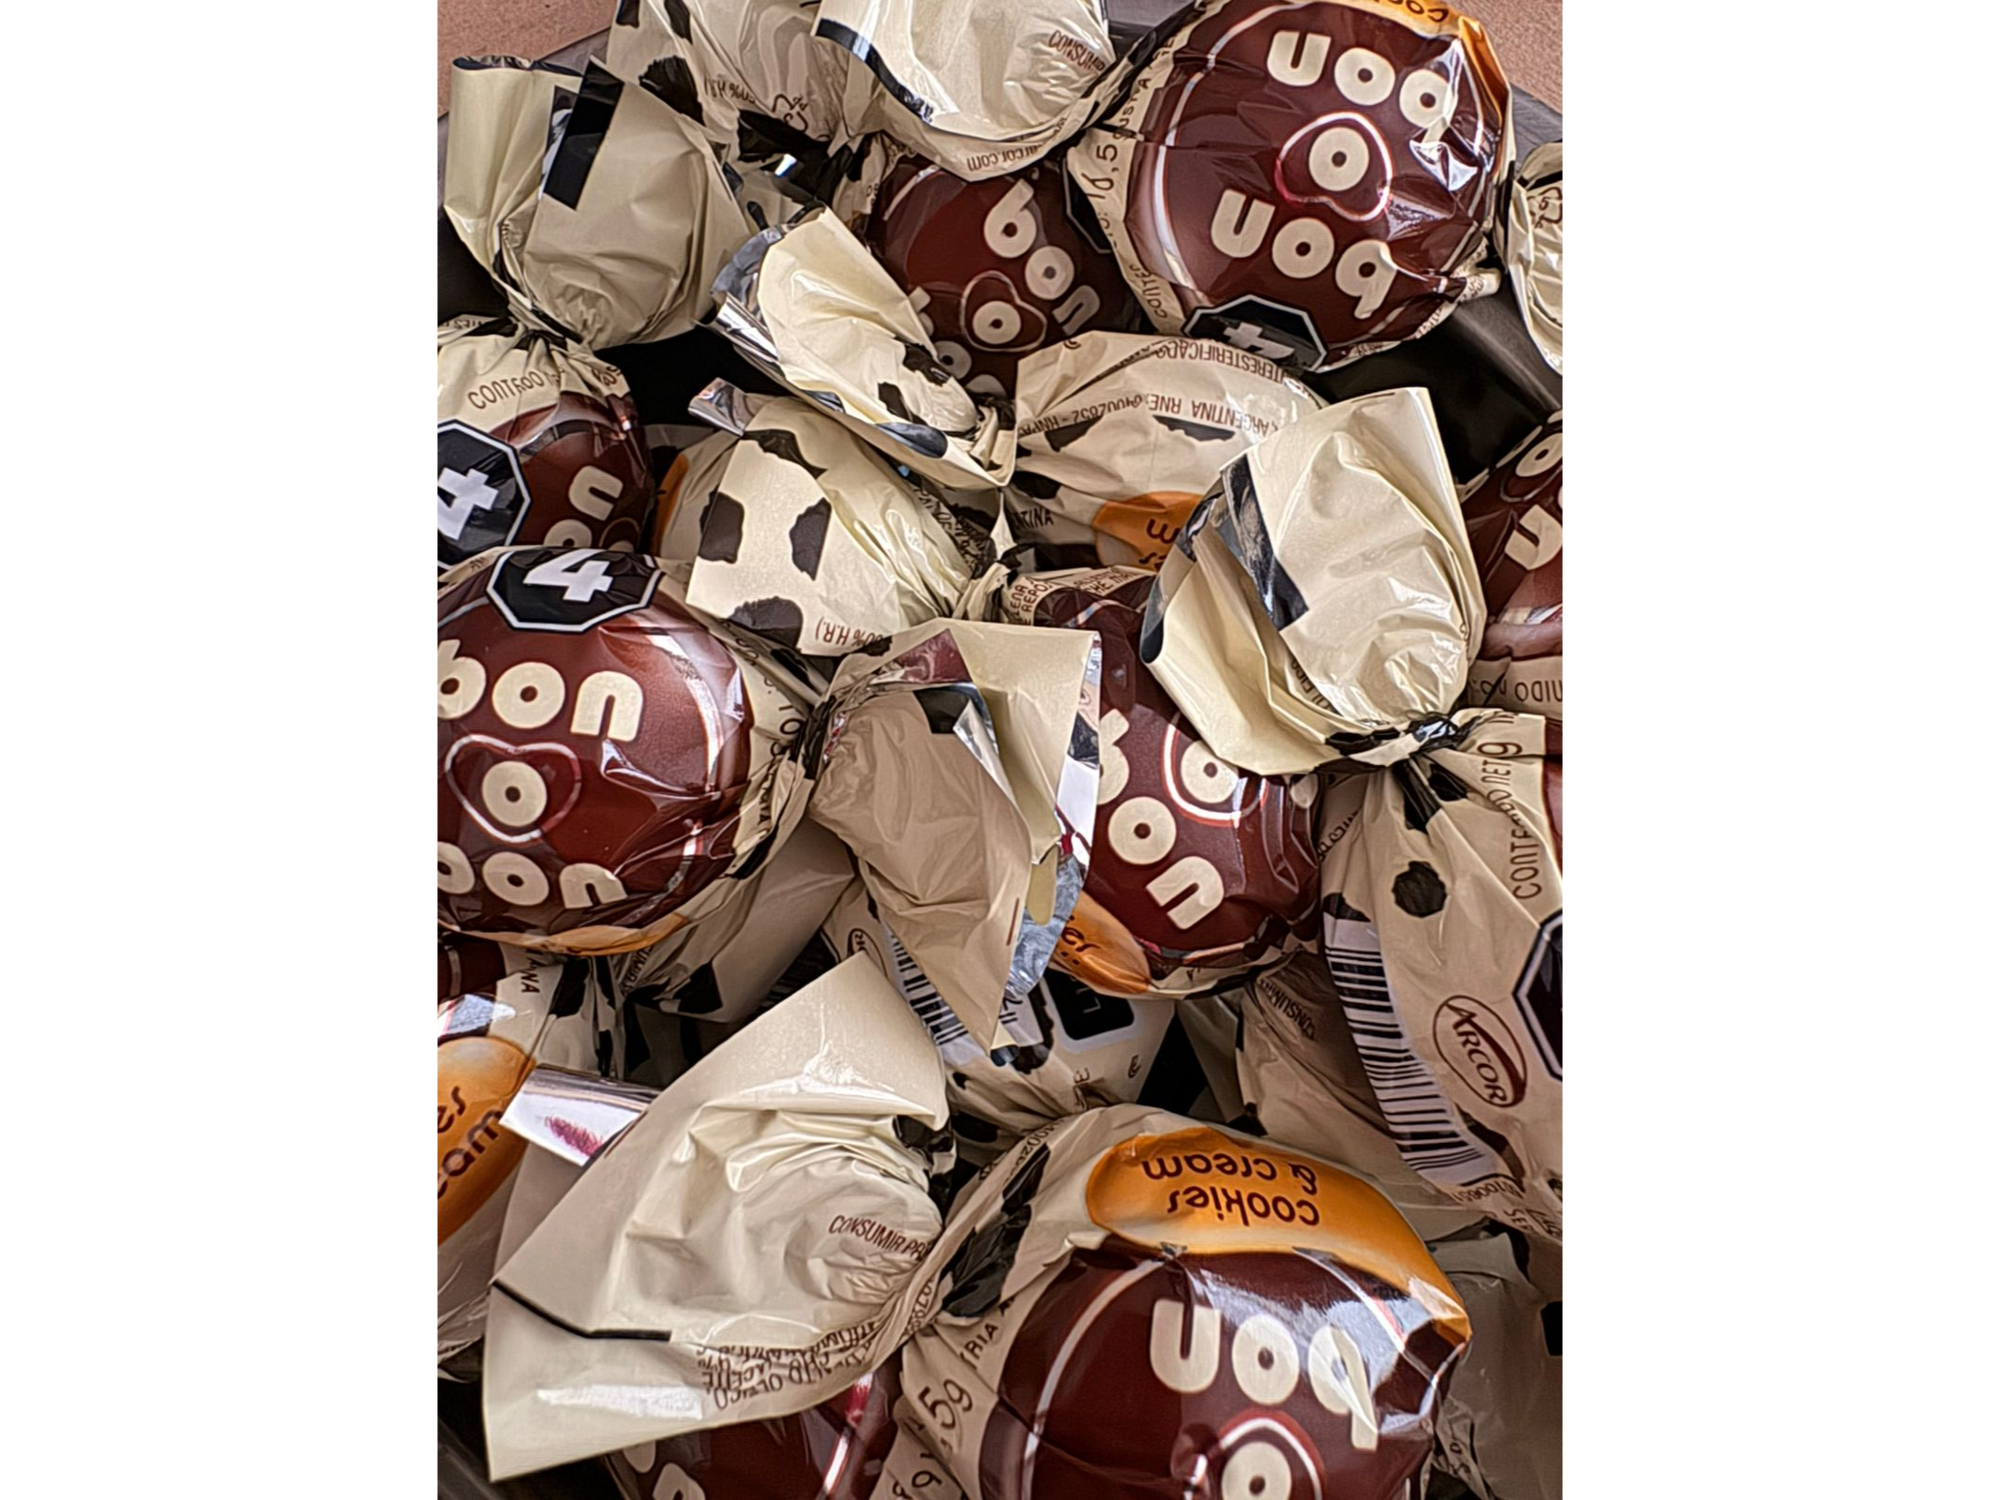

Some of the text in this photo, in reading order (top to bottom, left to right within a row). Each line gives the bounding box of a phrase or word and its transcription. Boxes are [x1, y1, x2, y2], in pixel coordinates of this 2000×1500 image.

[1267, 30, 1457, 145] bon
[984, 178, 1101, 337] bon
[1211, 189, 1398, 320] bon
[522, 551, 614, 603] 4
[437, 638, 644, 742] bon
[1445, 1002, 1512, 1104] ARCOR
[1141, 1152, 1279, 1182] cream
[1167, 1184, 1320, 1227] cookies
[828, 1214, 905, 1253] CONSUMIR
[1149, 1298, 1379, 1452] bon
